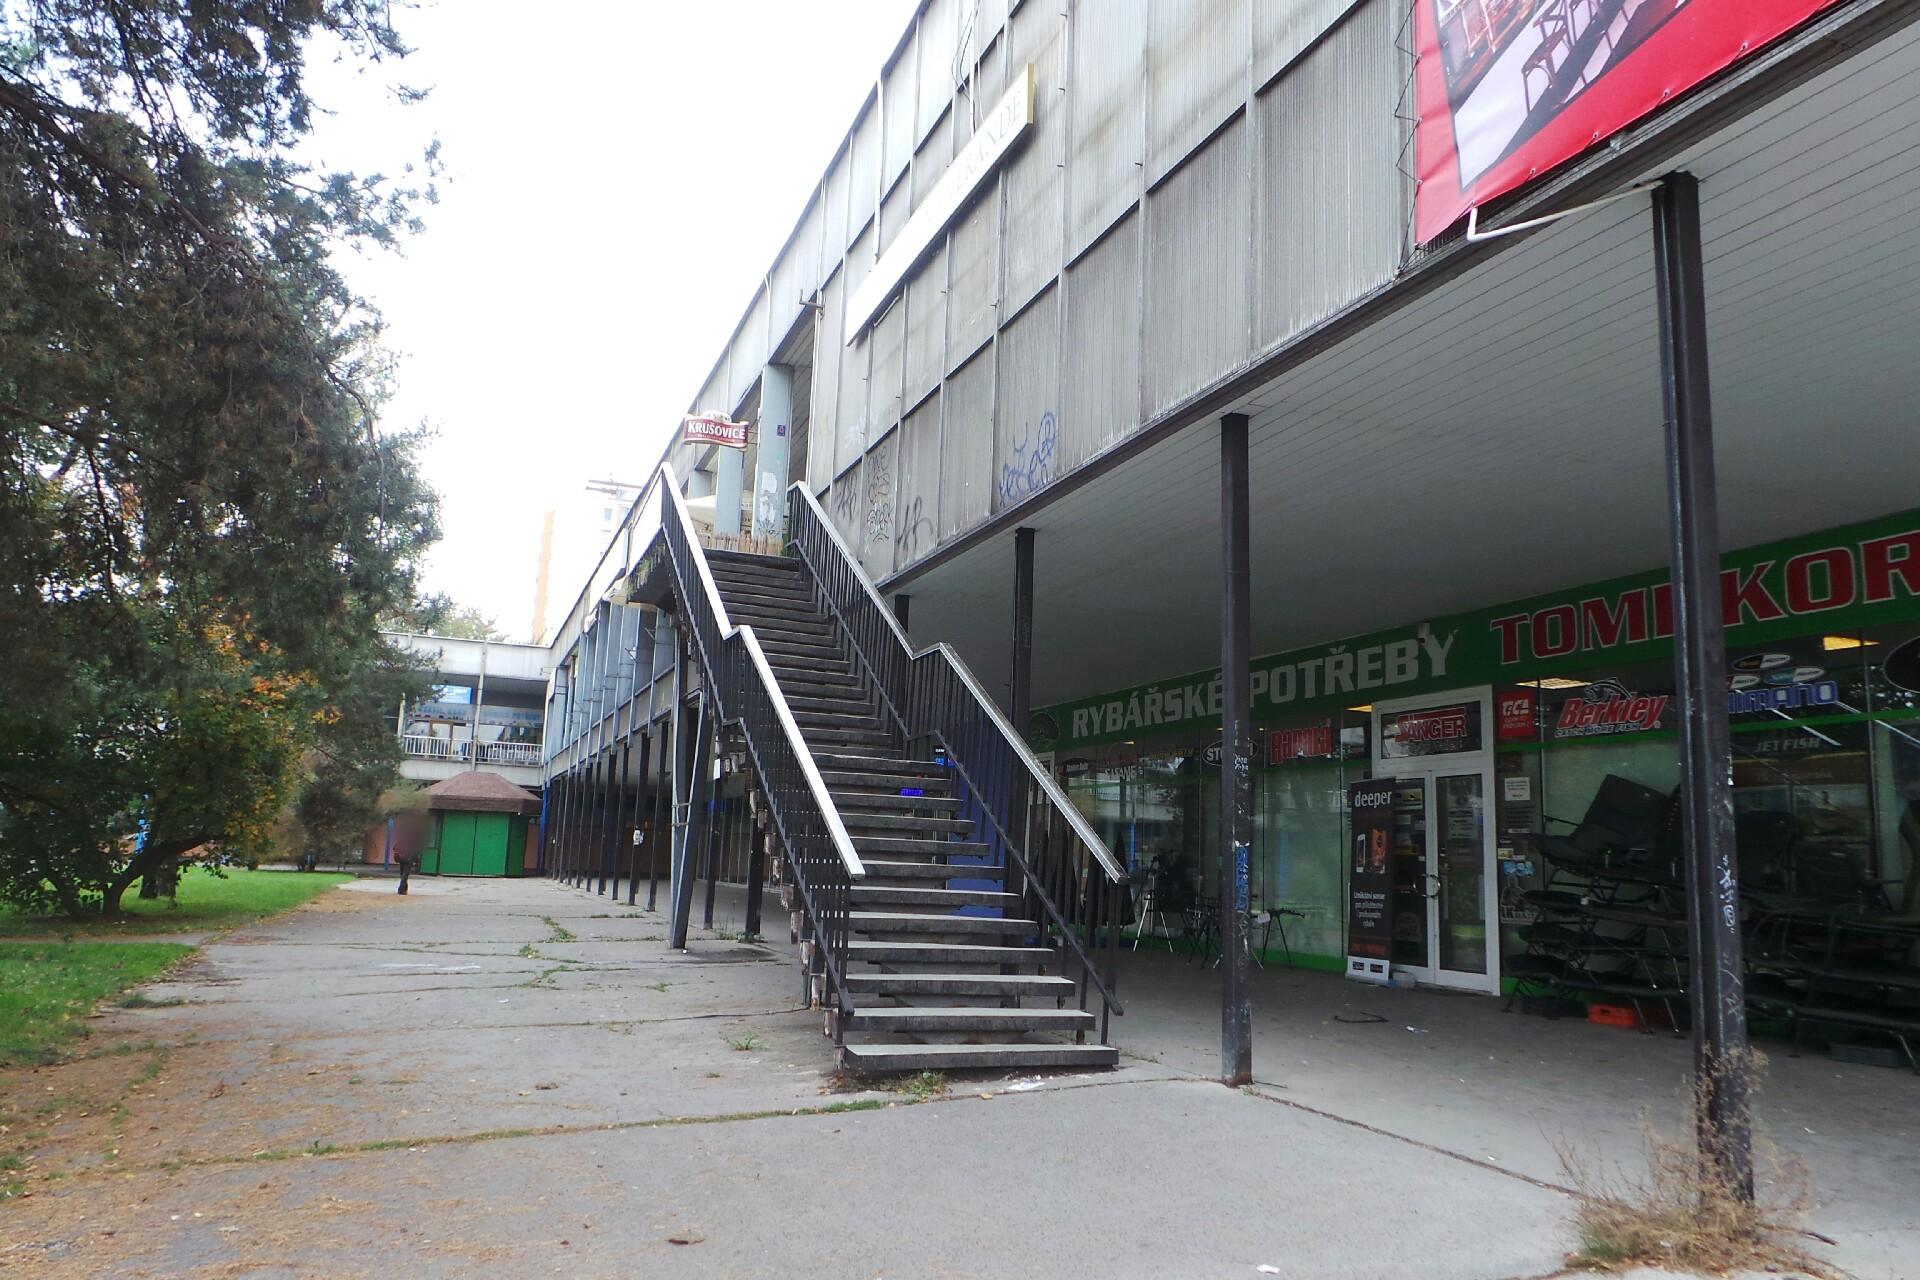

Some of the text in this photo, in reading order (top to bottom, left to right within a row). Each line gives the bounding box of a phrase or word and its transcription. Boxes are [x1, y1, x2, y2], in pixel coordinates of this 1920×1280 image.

[687, 420, 746, 440] KRUŠOVICE
[1072, 630, 1456, 739] RYBÁŘSKÉ POTŘEBY
[1557, 693, 1668, 730] Berkley
[1783, 737, 1820, 751] FISH
[1354, 790, 1392, 808] deeper
